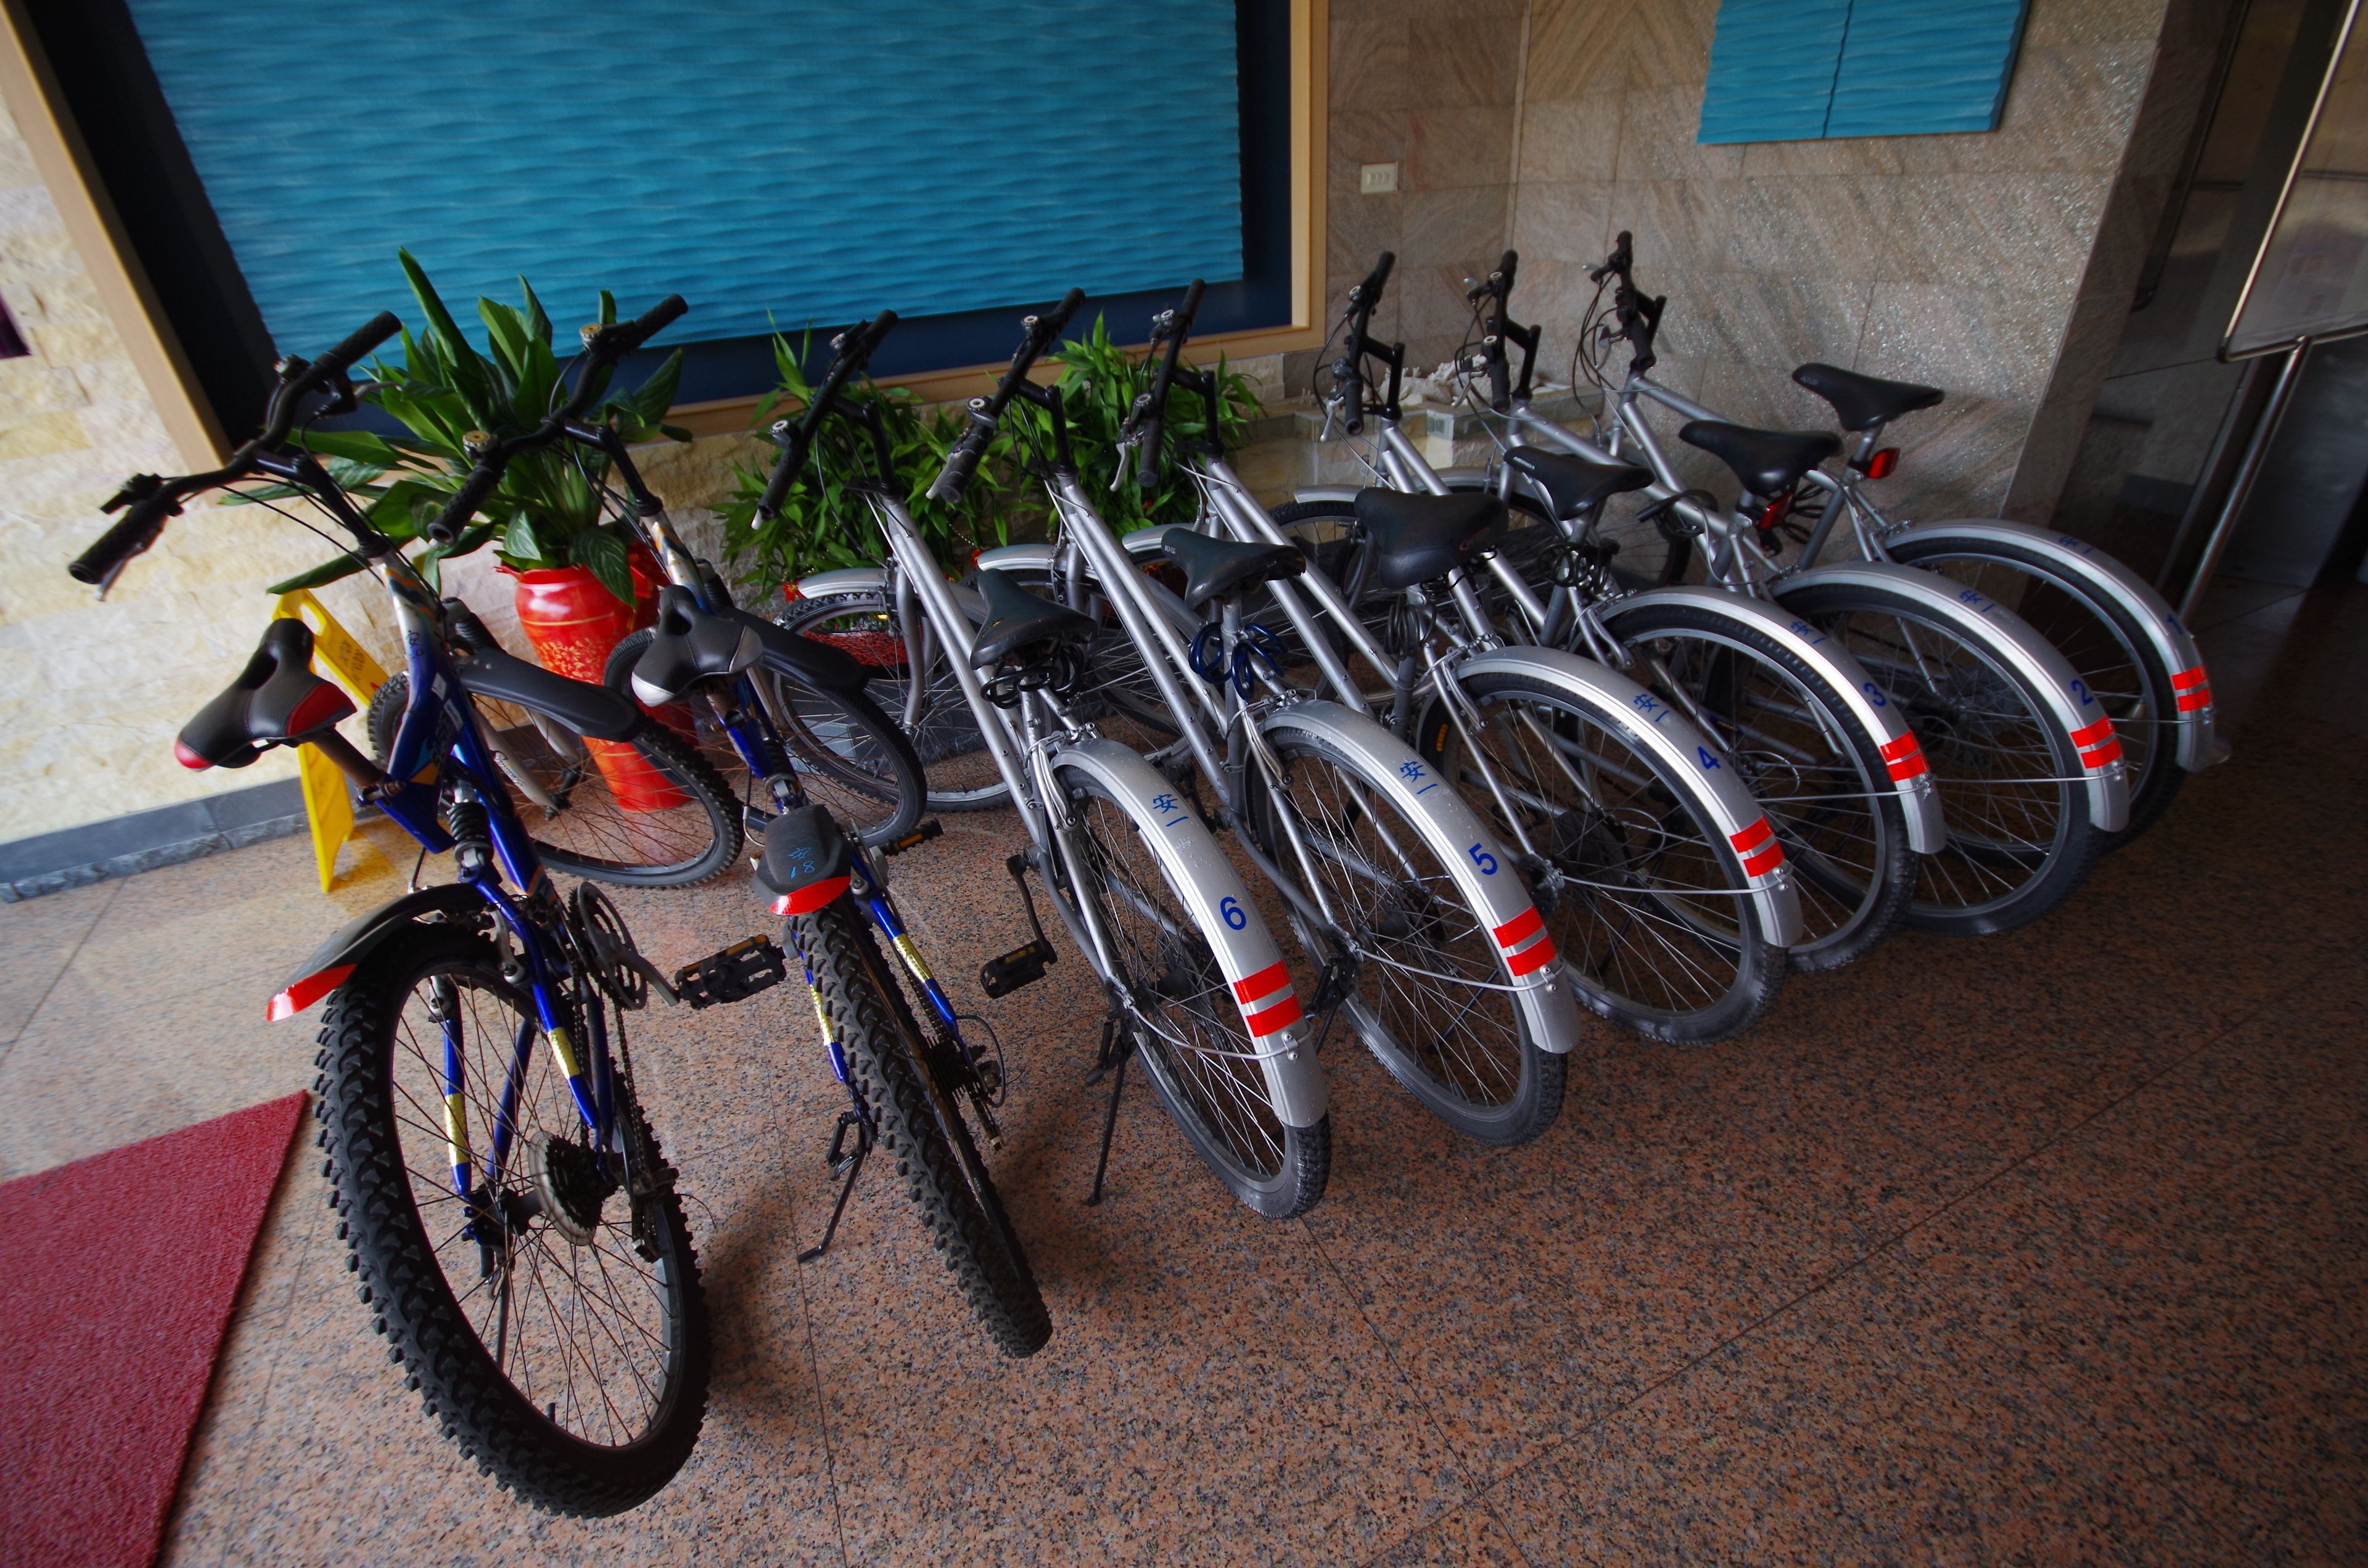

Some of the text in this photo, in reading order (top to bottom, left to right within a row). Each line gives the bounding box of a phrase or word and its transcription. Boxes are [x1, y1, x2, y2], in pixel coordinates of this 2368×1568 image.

[1164, 544, 1177, 554] KHS
[2167, 614, 2184, 635] 1
[1862, 682, 1887, 707] 3
[2071, 679, 2094, 706] 2
[1697, 745, 1722, 770] 4
[790, 860, 815, 879] 18
[1468, 842, 1498, 876] 5
[1219, 896, 1247, 930] 6
